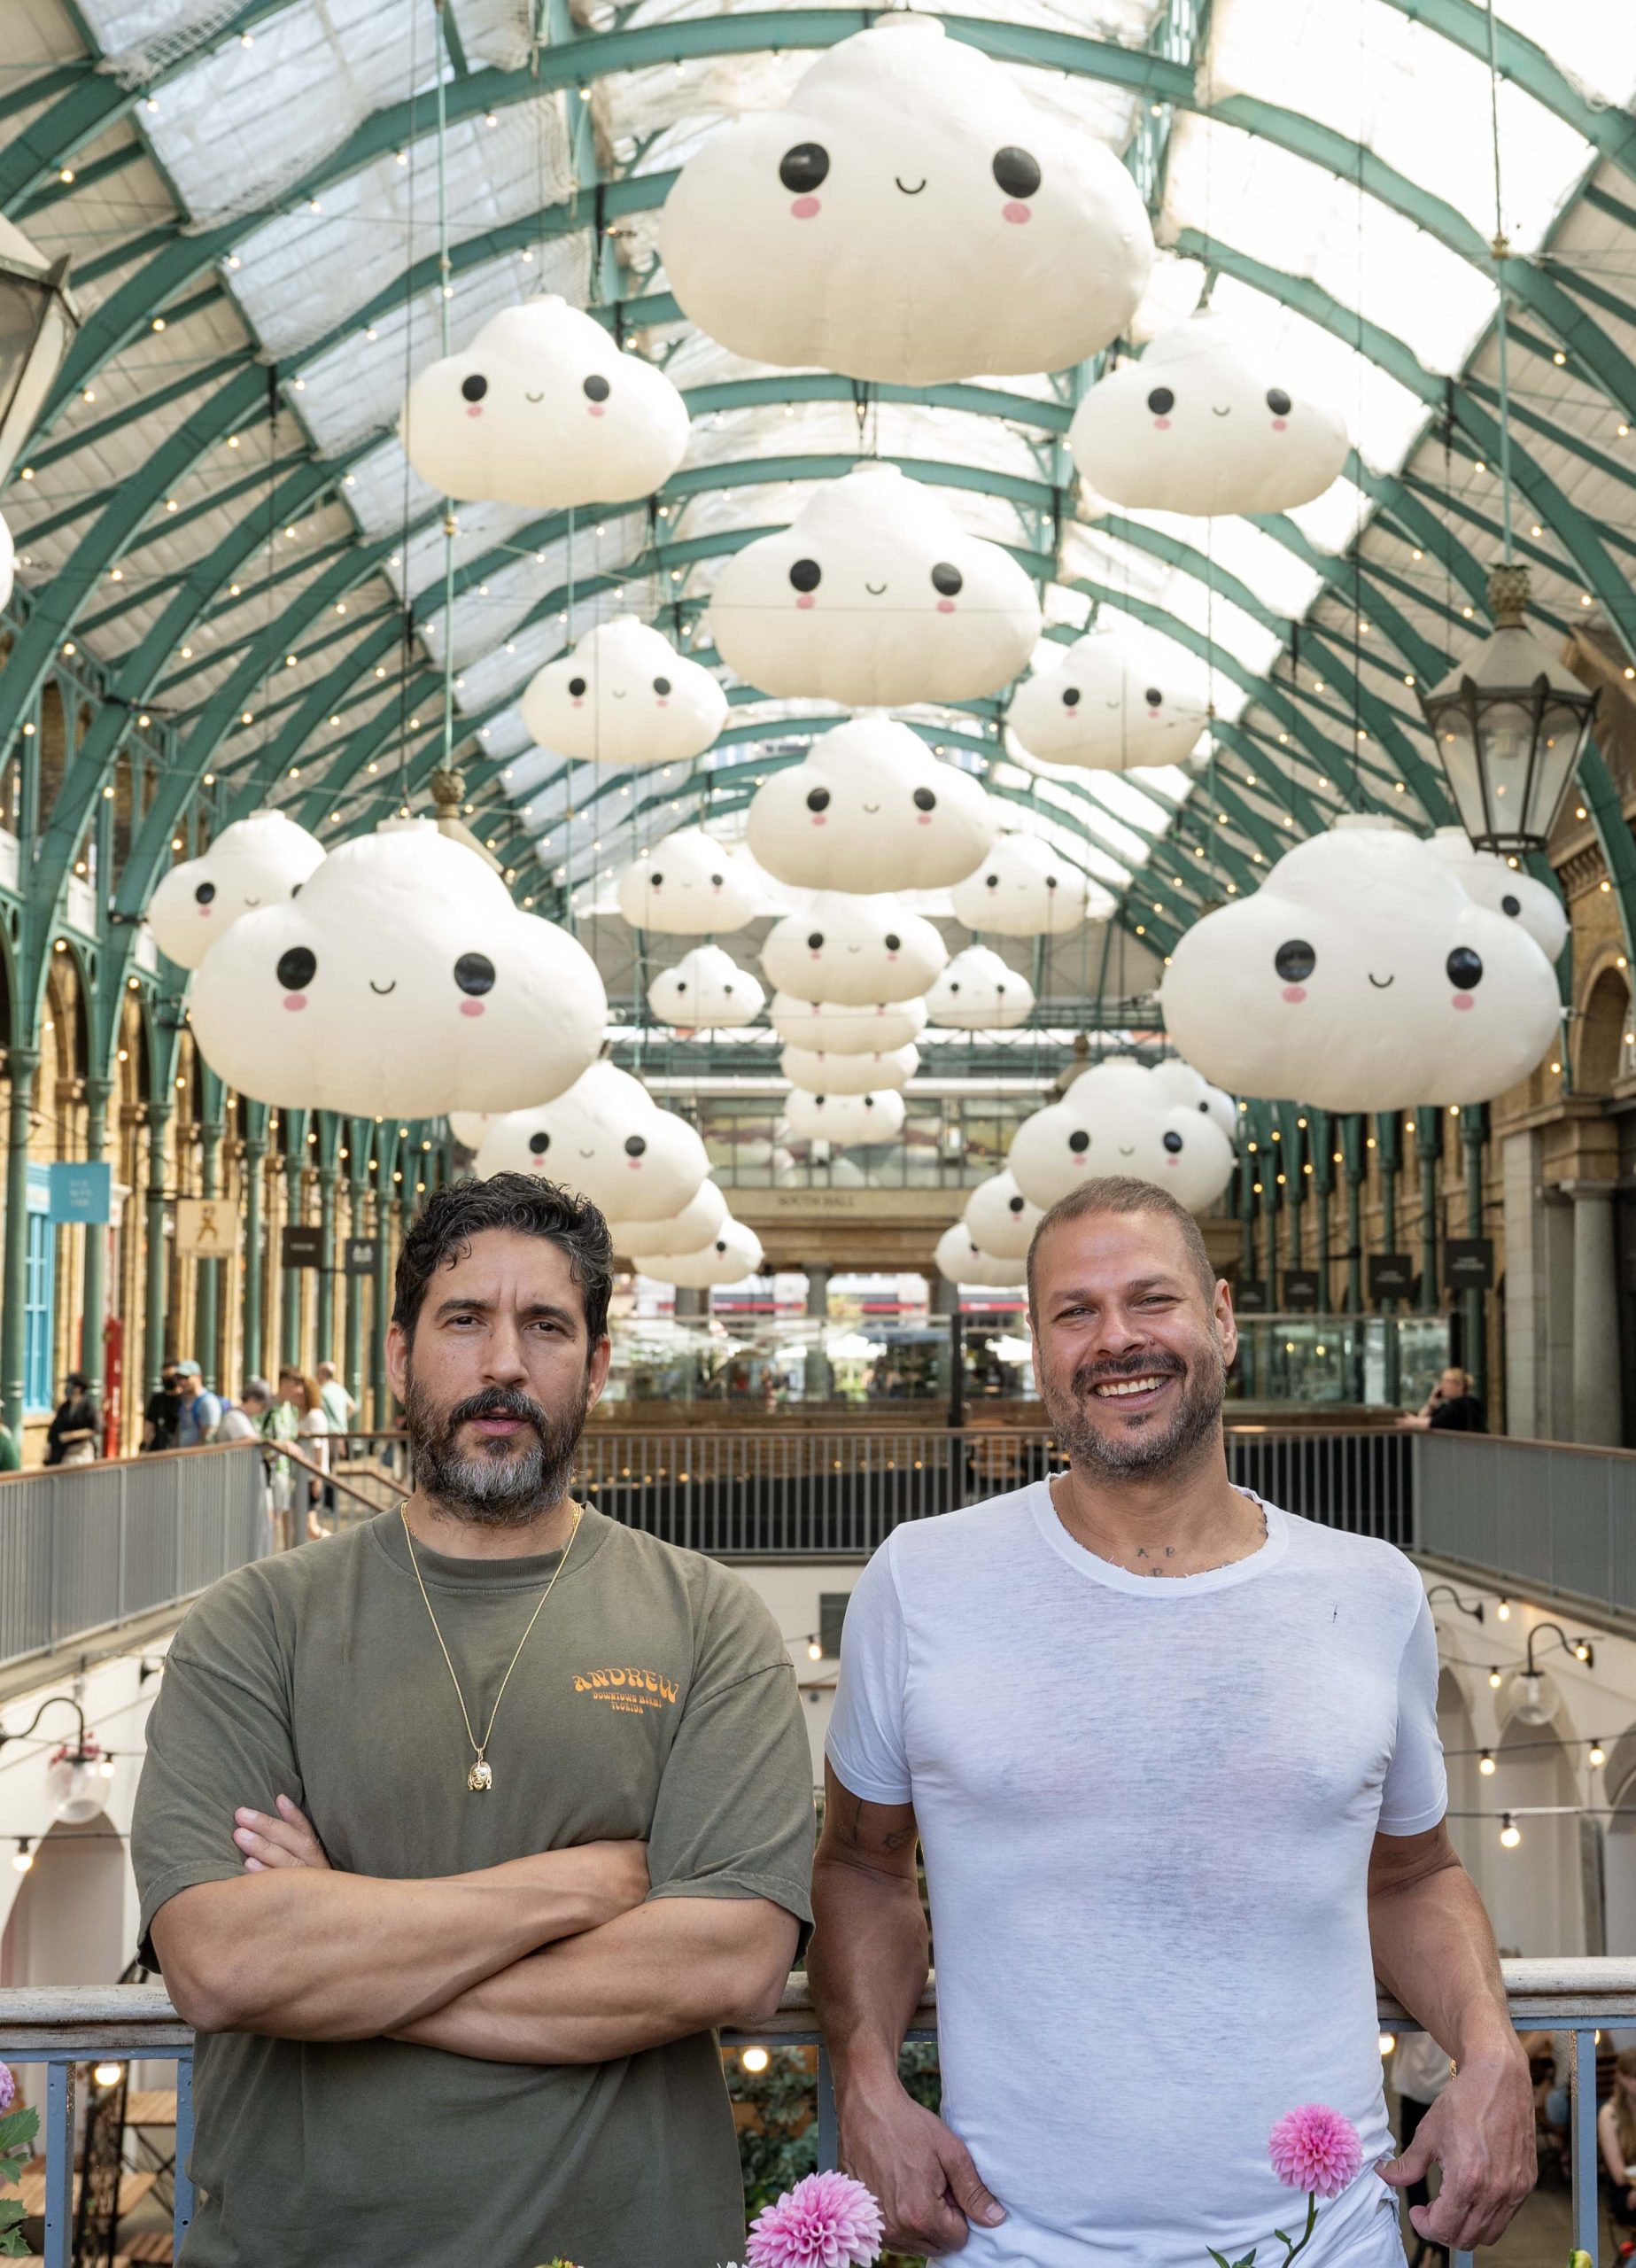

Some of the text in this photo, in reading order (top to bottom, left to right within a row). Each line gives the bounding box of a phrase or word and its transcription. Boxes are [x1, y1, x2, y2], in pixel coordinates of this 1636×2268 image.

[571, 1667, 679, 1704] ANDREW
[593, 1691, 637, 1703] DOWNTOWN
[611, 1702, 644, 1713] FLORIDA
